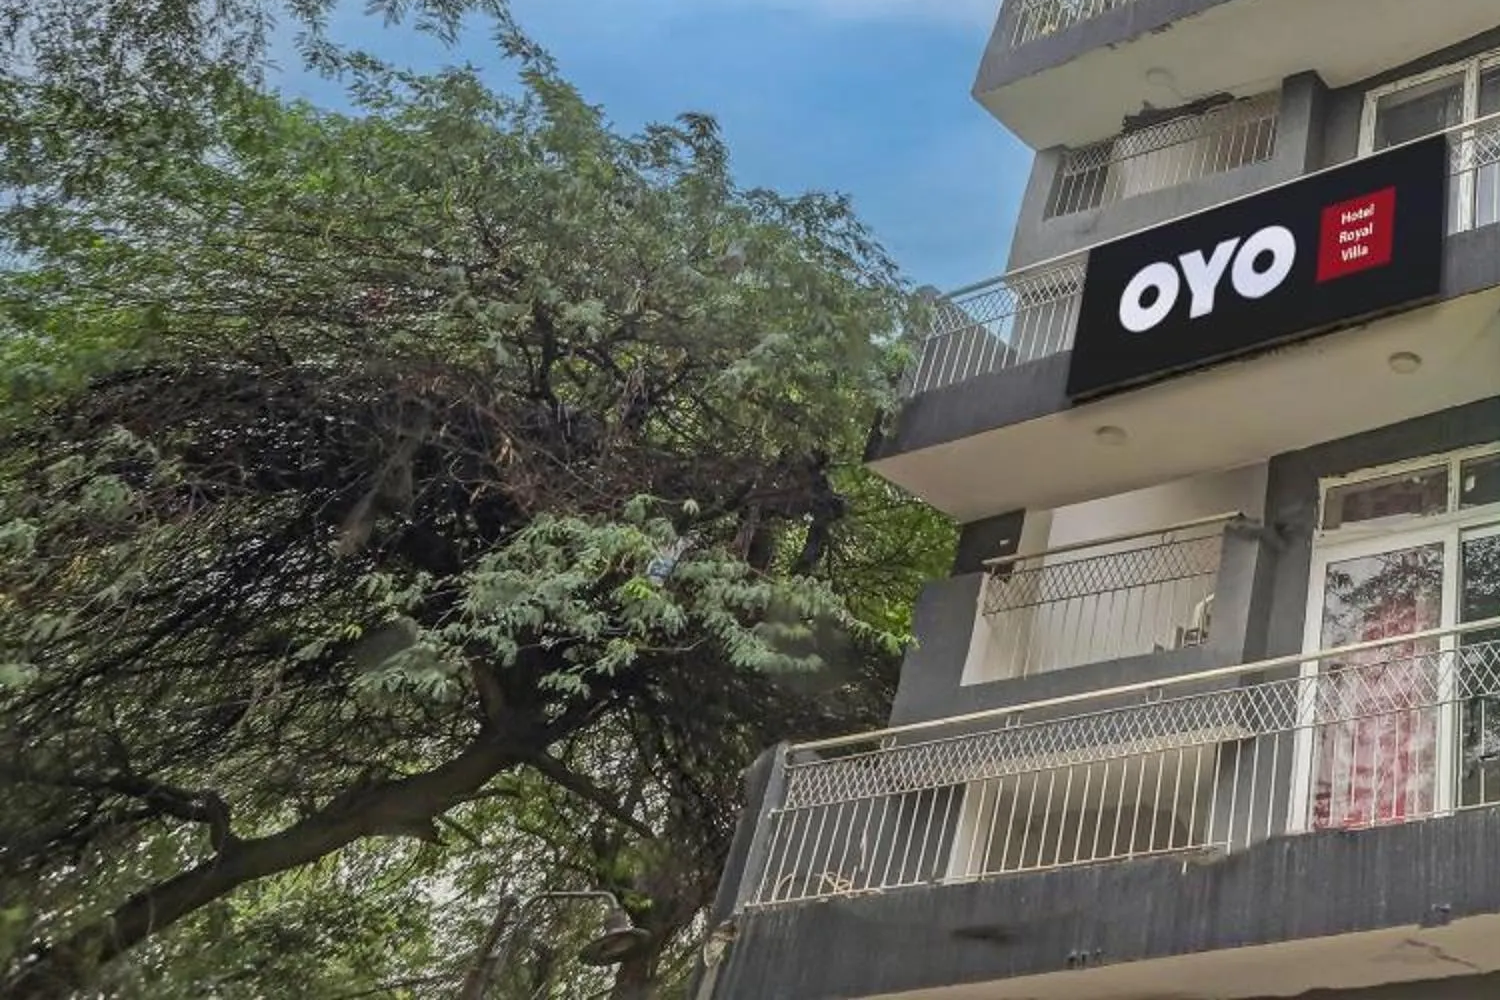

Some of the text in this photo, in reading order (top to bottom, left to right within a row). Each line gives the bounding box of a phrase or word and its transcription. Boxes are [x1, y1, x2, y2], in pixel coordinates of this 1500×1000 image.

[1340, 203, 1376, 225] Hotel
[1338, 221, 1374, 244] Royal
[1340, 244, 1370, 262] Villa
[1118, 225, 1297, 334] OYO
